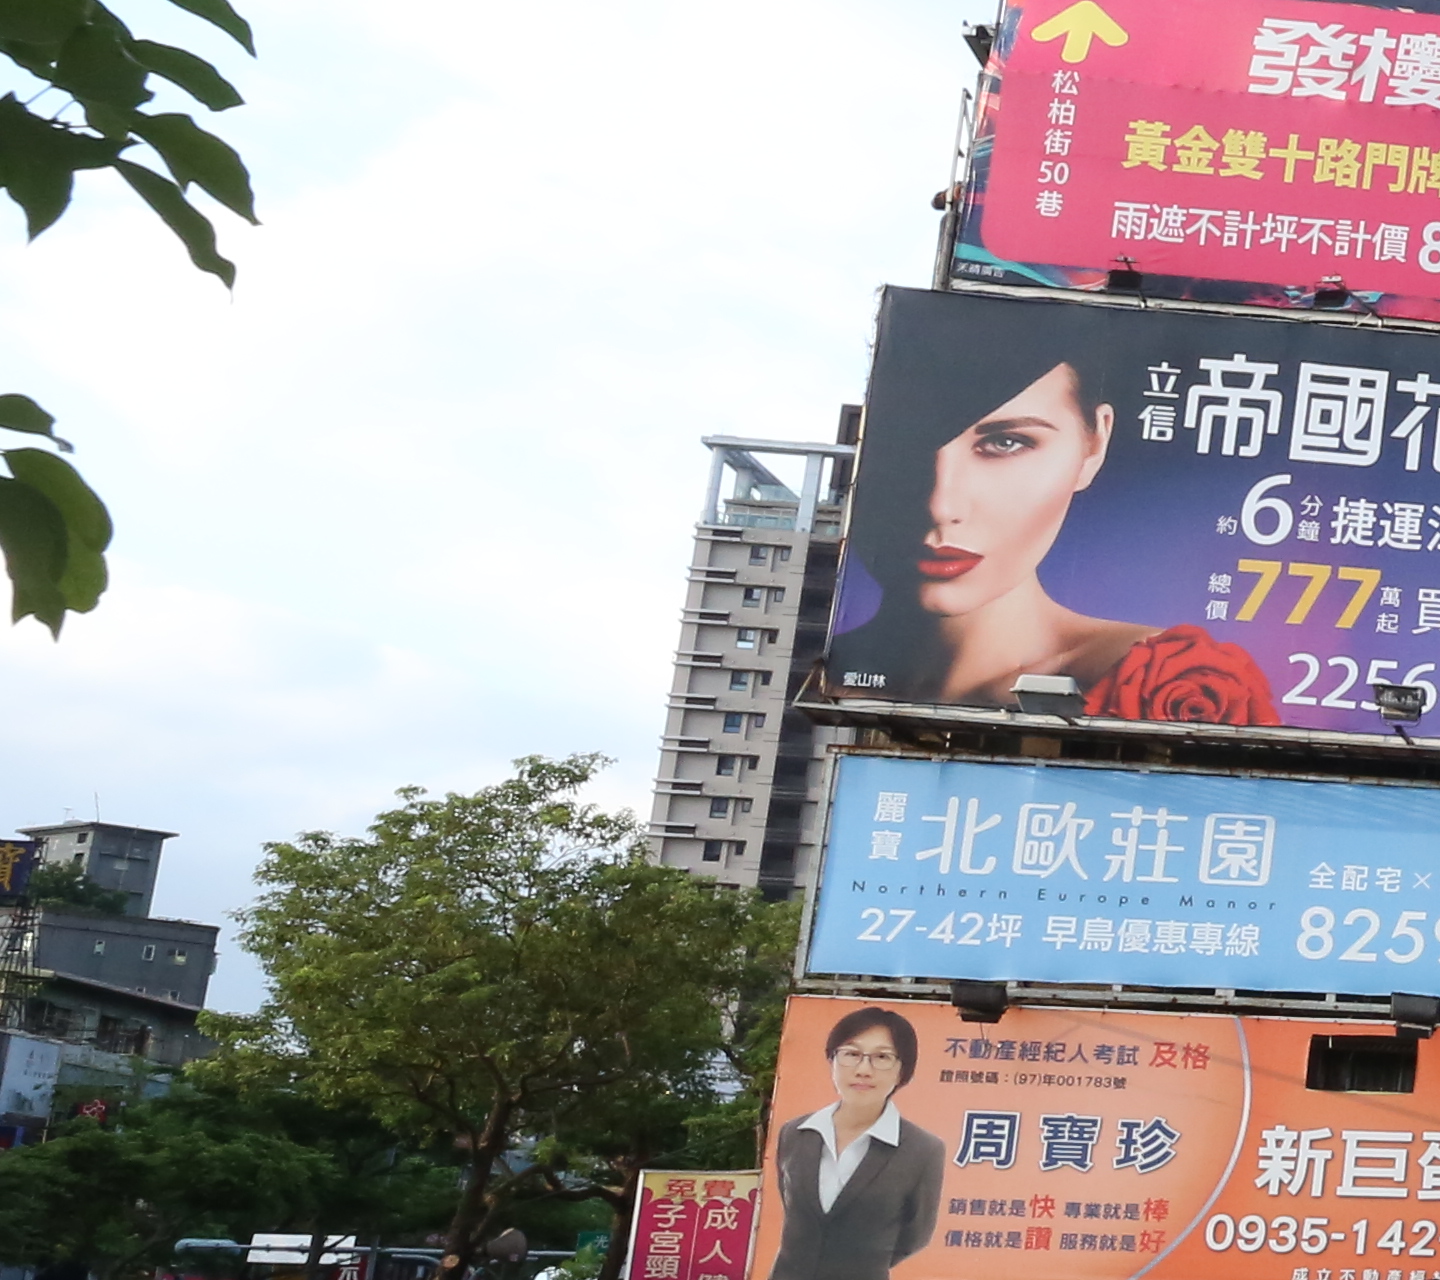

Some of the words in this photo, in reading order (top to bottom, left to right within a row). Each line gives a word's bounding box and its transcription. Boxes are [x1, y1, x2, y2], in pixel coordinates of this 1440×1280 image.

[1034, 68, 1082, 219] 松柏街50巷
[1111, 201, 1410, 264] 雨遮不計坪不計價
[1137, 362, 1181, 443] 立信
[868, 791, 908, 861] 麗寶
[915, 796, 1276, 887] 北歐莊園
[852, 880, 1008, 901] Northern
[1038, 888, 1150, 908] Europe
[1180, 895, 1277, 911] Manor
[856, 907, 1023, 949] 27-42坪
[1042, 916, 1261, 958] 早鳥優惠專線
[944, 1037, 1141, 1068] 不動產經紀人考試
[1148, 1040, 1213, 1072] 及格
[953, 1110, 1182, 1174] 周寶珍
[948, 1195, 1058, 1221] 銷售就是快
[1064, 1196, 1171, 1225] 專業就是棒
[1058, 1230, 1168, 1256] 服務就是好
